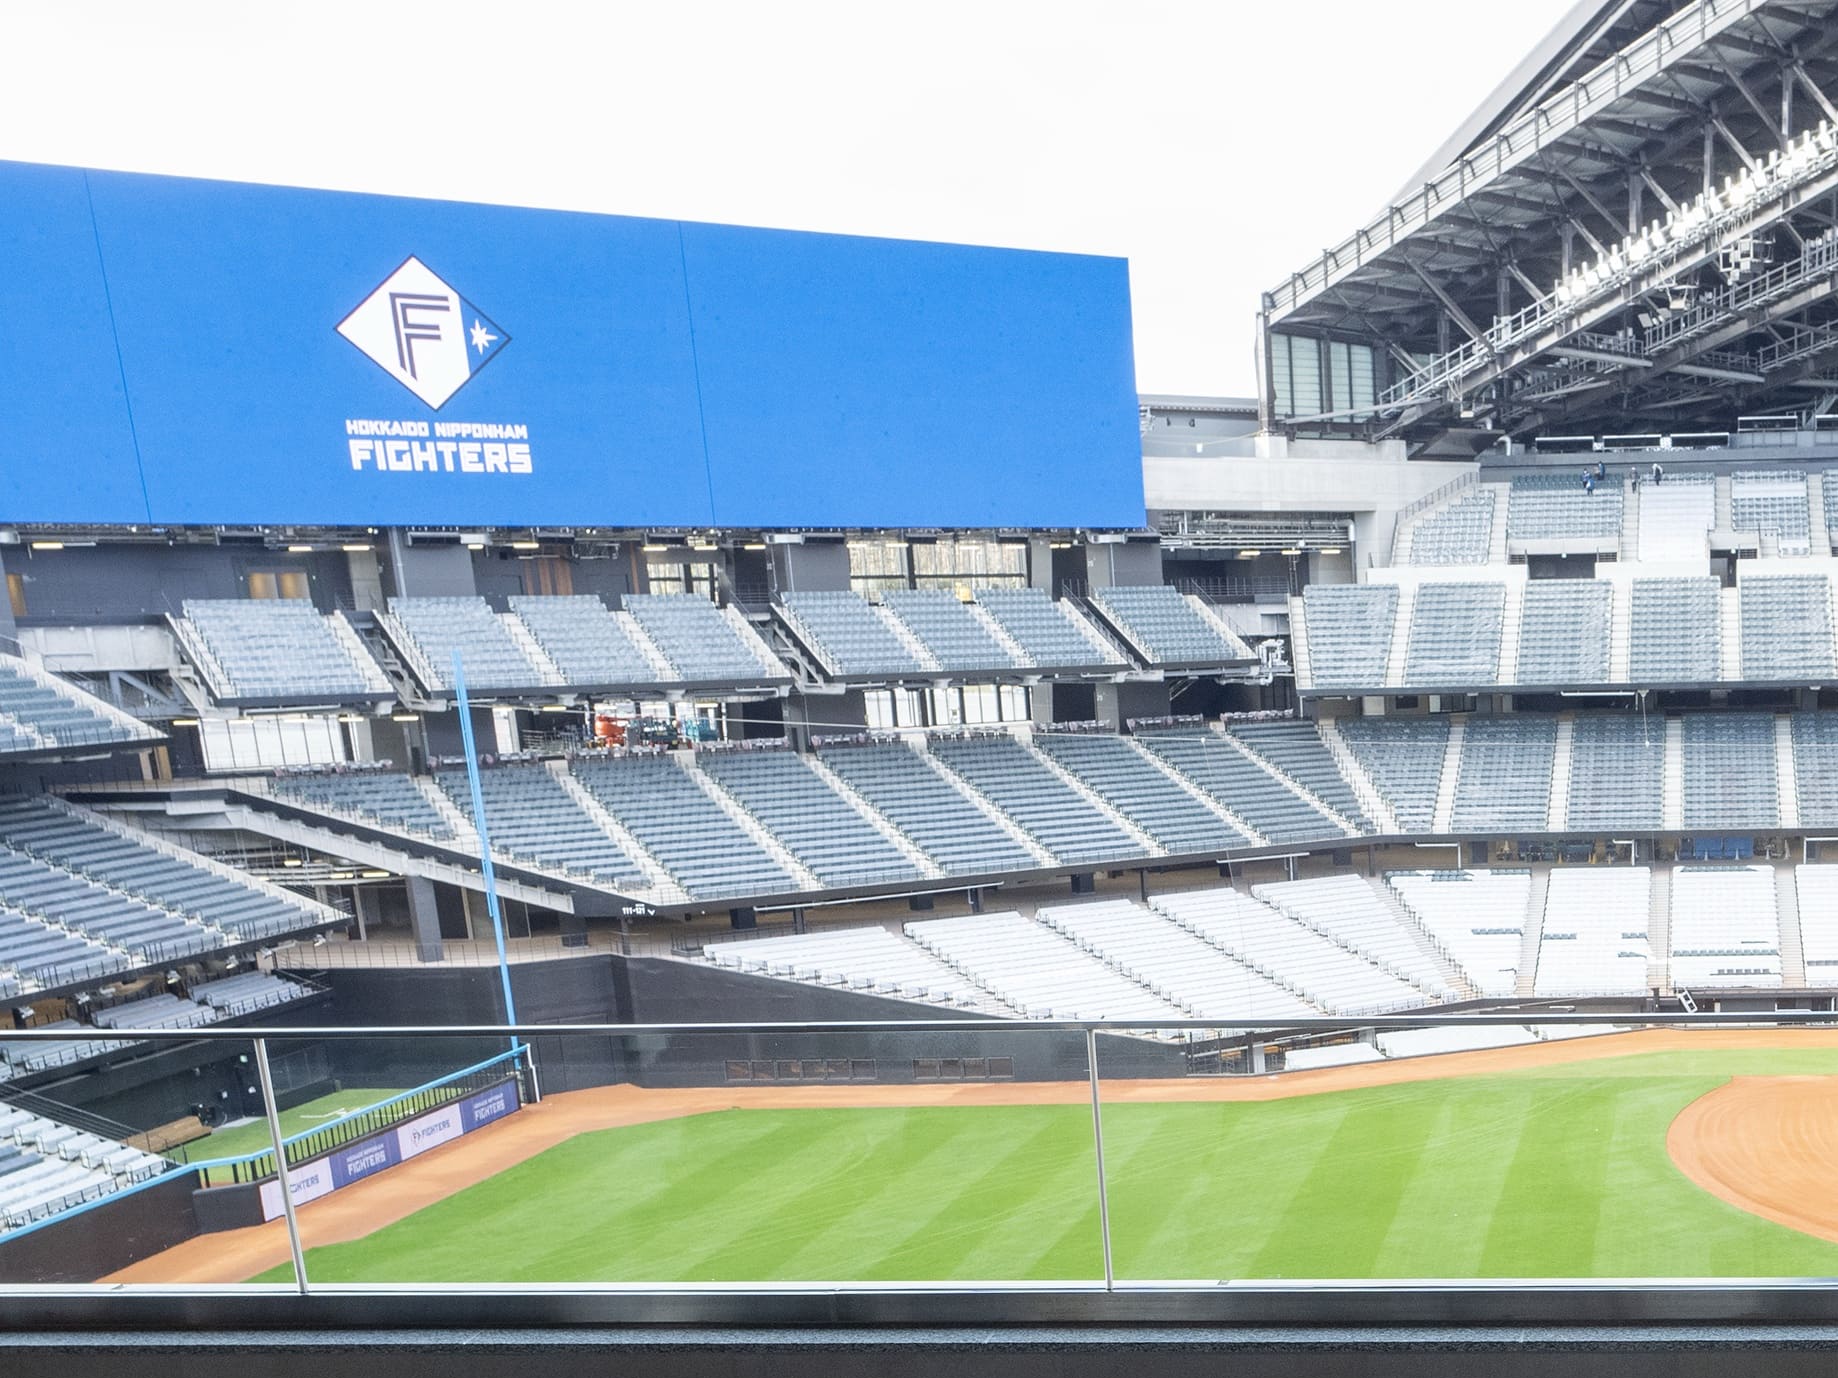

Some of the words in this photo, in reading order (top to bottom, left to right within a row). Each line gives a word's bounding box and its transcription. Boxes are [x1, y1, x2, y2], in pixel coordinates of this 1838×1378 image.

[345, 419, 430, 437] HOKKAIDO
[434, 422, 528, 440] NIPPONHAM
[348, 439, 533, 474] FIGHTERS
[474, 1098, 506, 1121] FIGHTERS
[421, 1119, 451, 1138] FIGHTERS
[347, 1150, 386, 1176] FIGHTERS
